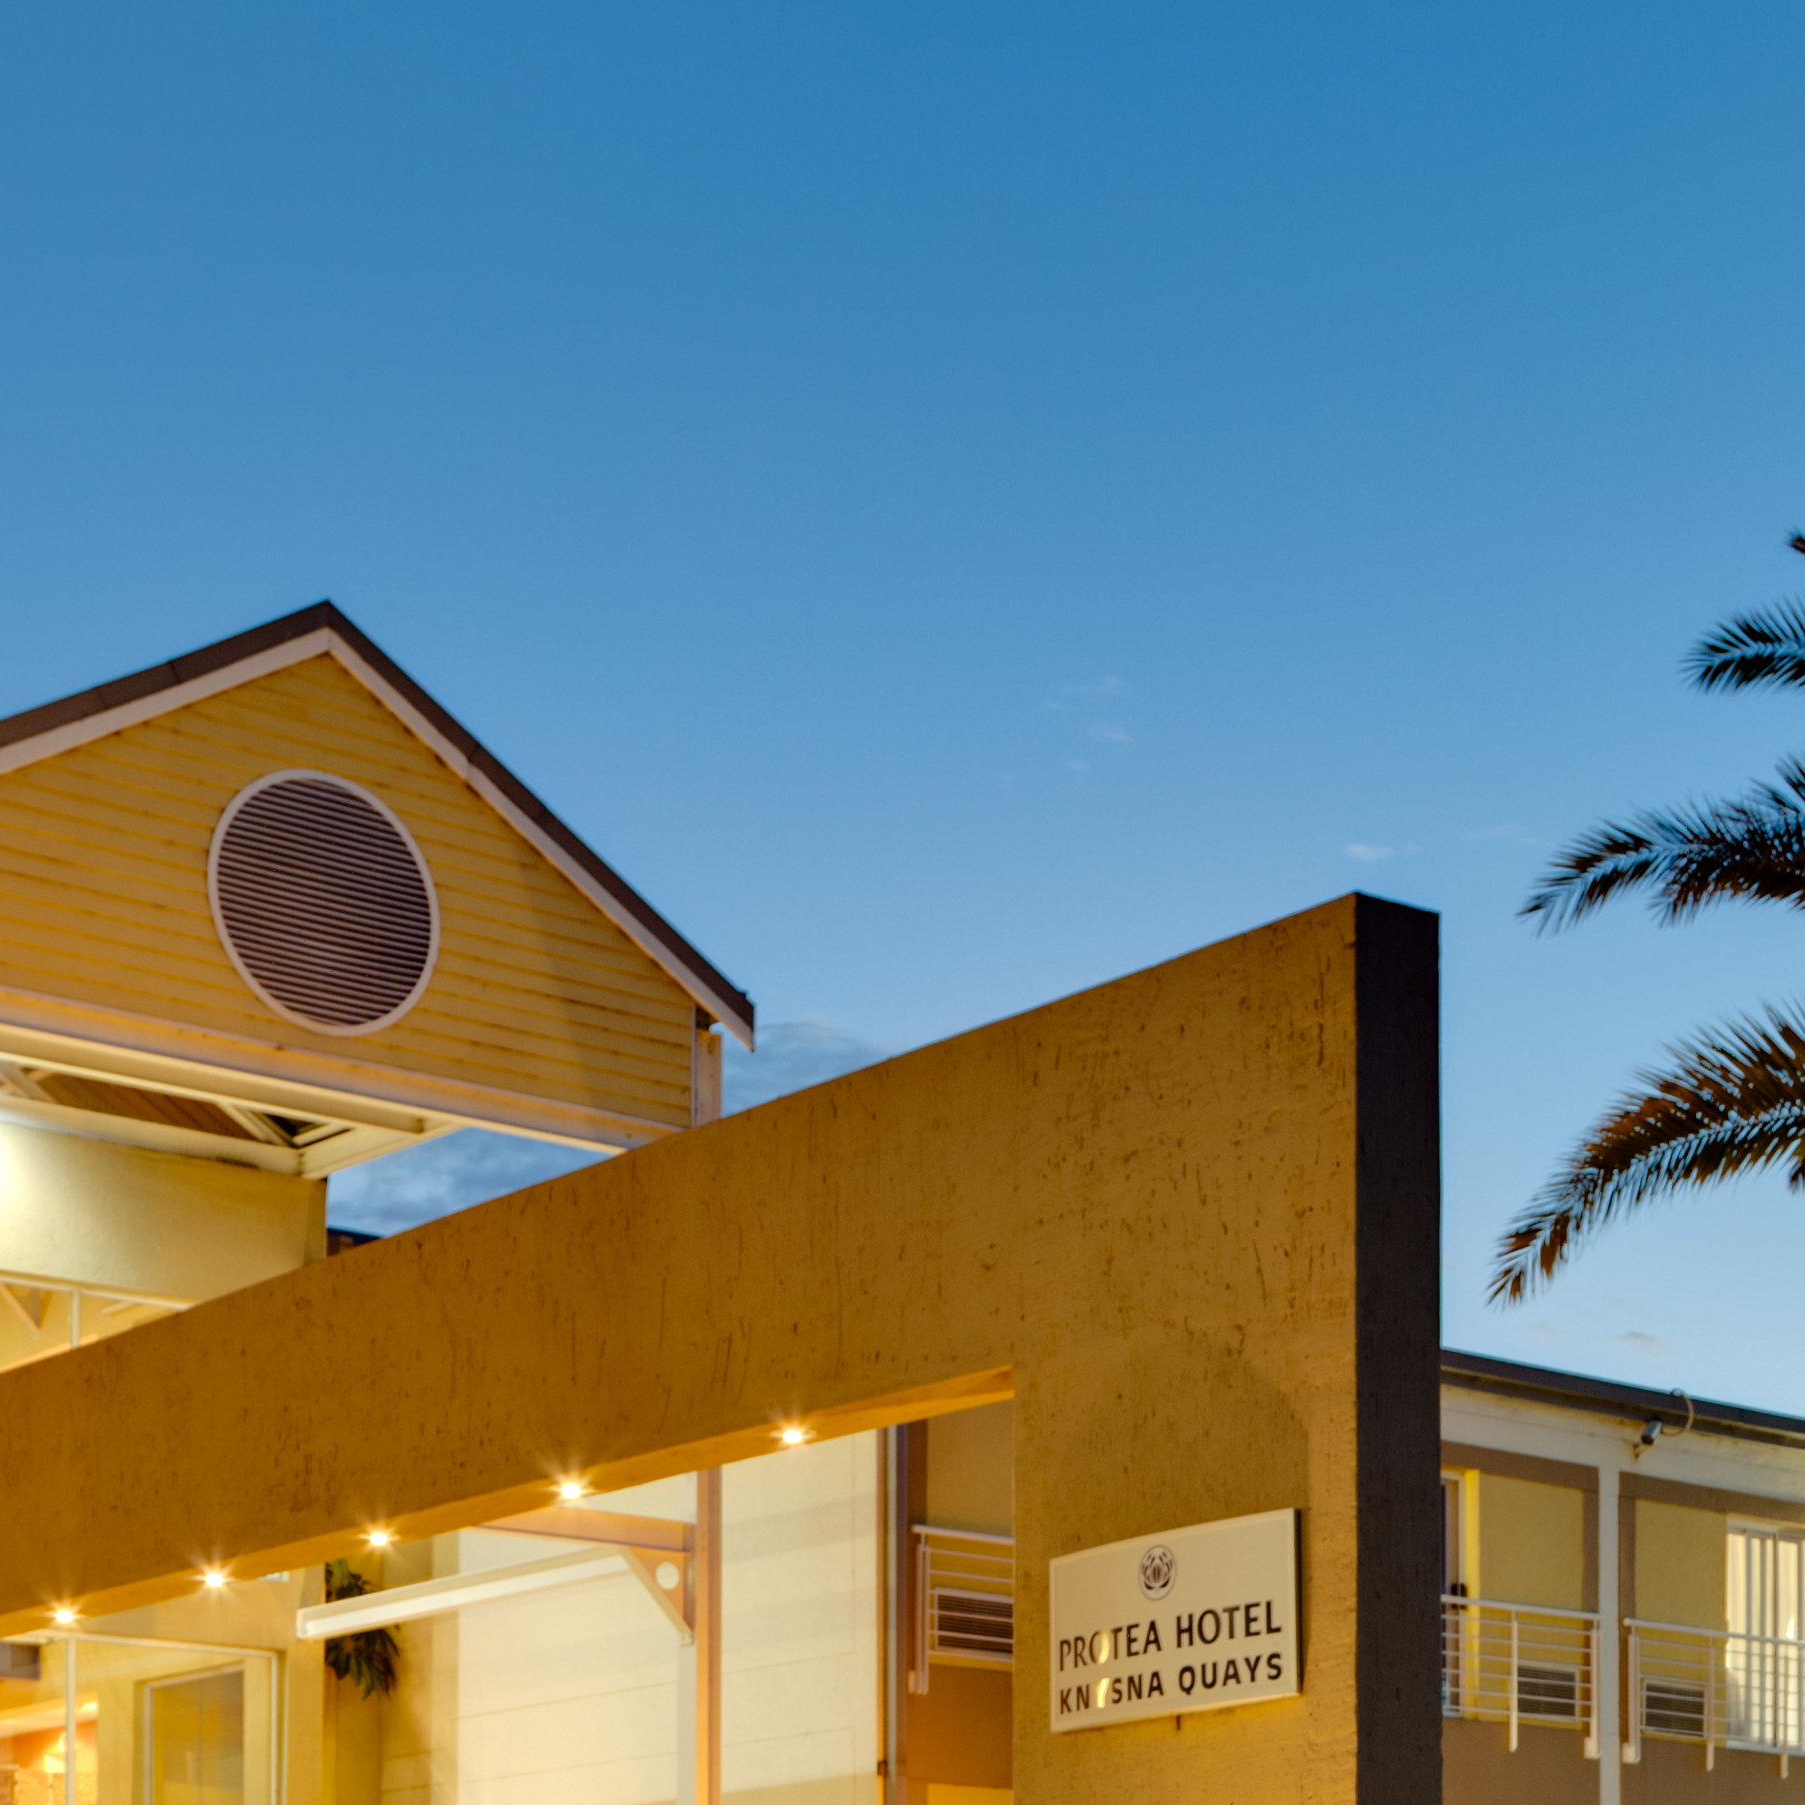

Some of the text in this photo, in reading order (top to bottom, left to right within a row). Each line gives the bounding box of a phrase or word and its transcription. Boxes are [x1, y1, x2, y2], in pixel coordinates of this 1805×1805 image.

[1059, 1600, 1283, 1672] PROTEA HOTEL
[1059, 1653, 1283, 1715] KNYSNA QUAYS
